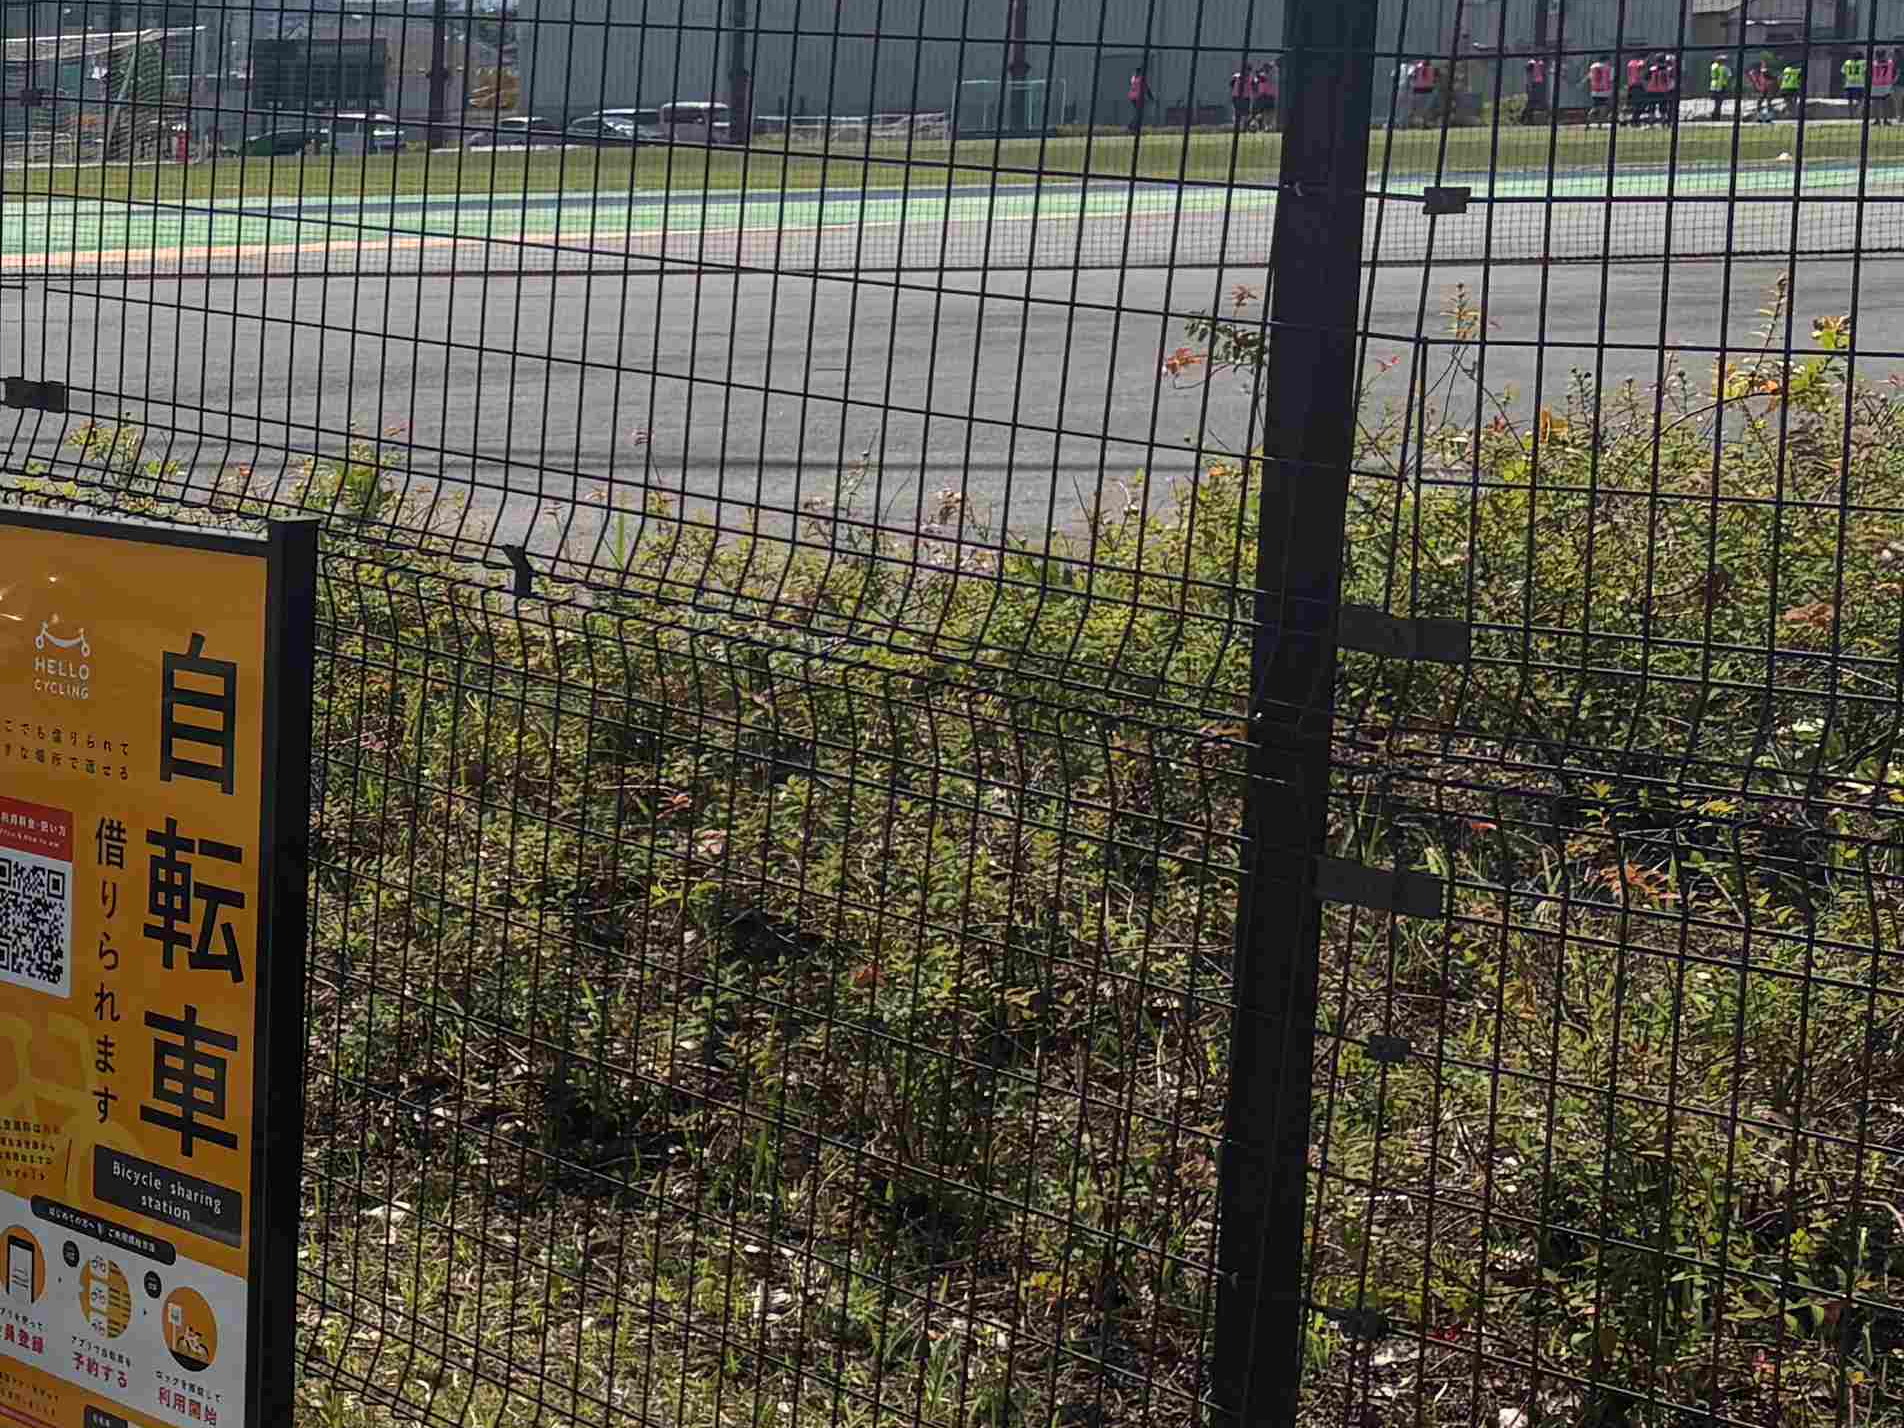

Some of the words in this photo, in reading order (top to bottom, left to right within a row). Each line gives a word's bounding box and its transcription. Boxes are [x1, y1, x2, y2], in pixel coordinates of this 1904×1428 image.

[34, 658, 90, 681] HELLO
[34, 678, 89, 700] CYCLING
[139, 632, 246, 1159] 自転車
[93, 815, 127, 1124] 借りられます
[112, 1160, 163, 1191] Bicycle
[169, 1177, 224, 1215] sharing
[140, 1192, 192, 1223] station
[72, 1350, 129, 1389] 予約する
